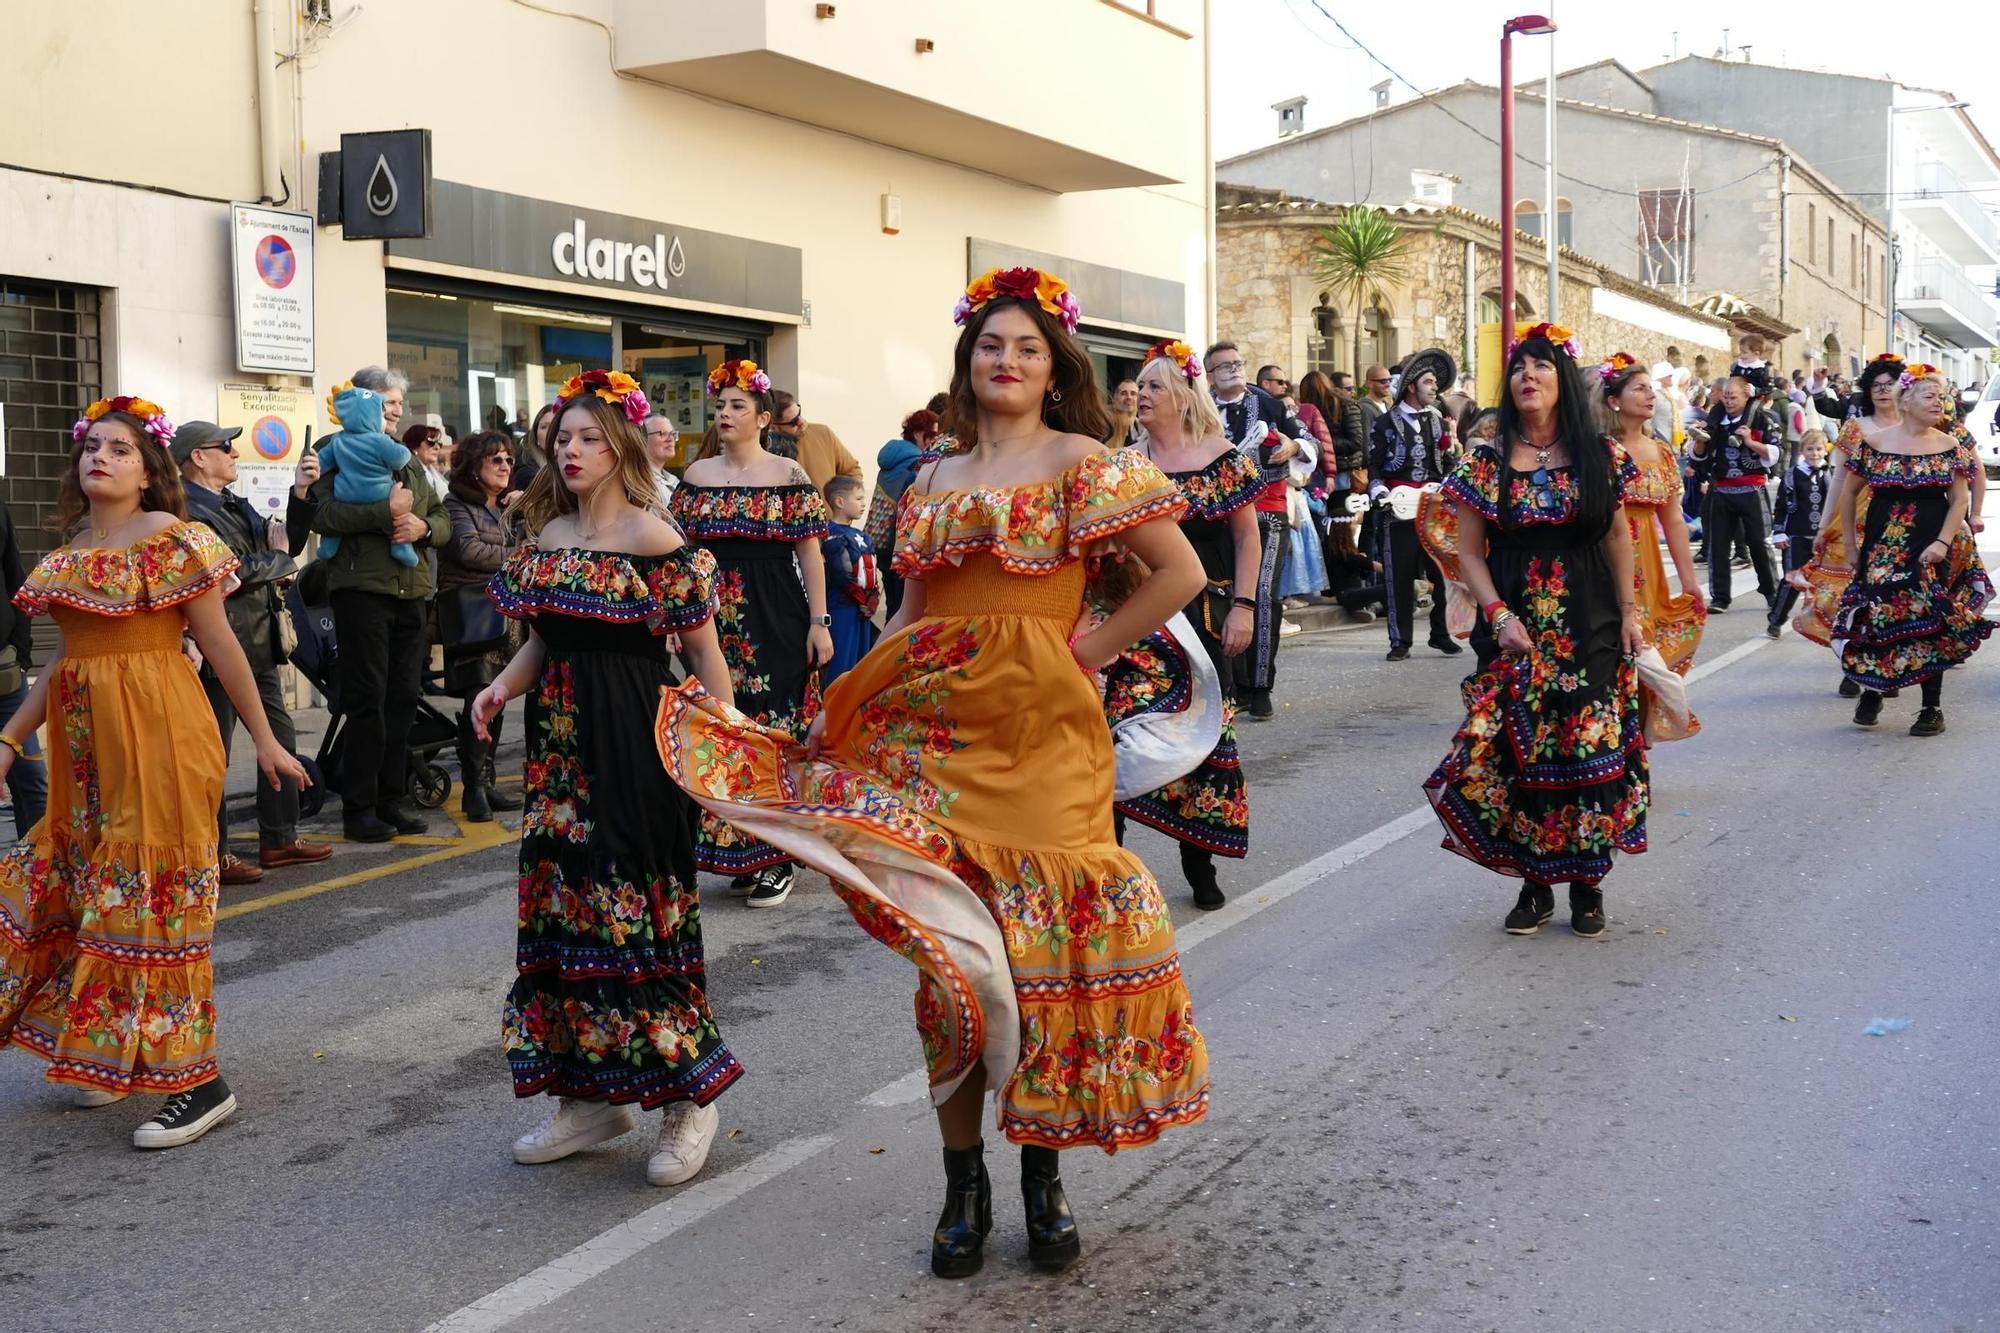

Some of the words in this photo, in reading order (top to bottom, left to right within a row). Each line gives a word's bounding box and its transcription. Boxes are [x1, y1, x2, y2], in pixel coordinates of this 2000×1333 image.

[250, 220, 280, 230] Ajuntament
[289, 224, 310, 234] l'Escala
[552, 217, 668, 290] clarel
[269, 296, 297, 304] laborables
[243, 402, 295, 412] Excepcional
